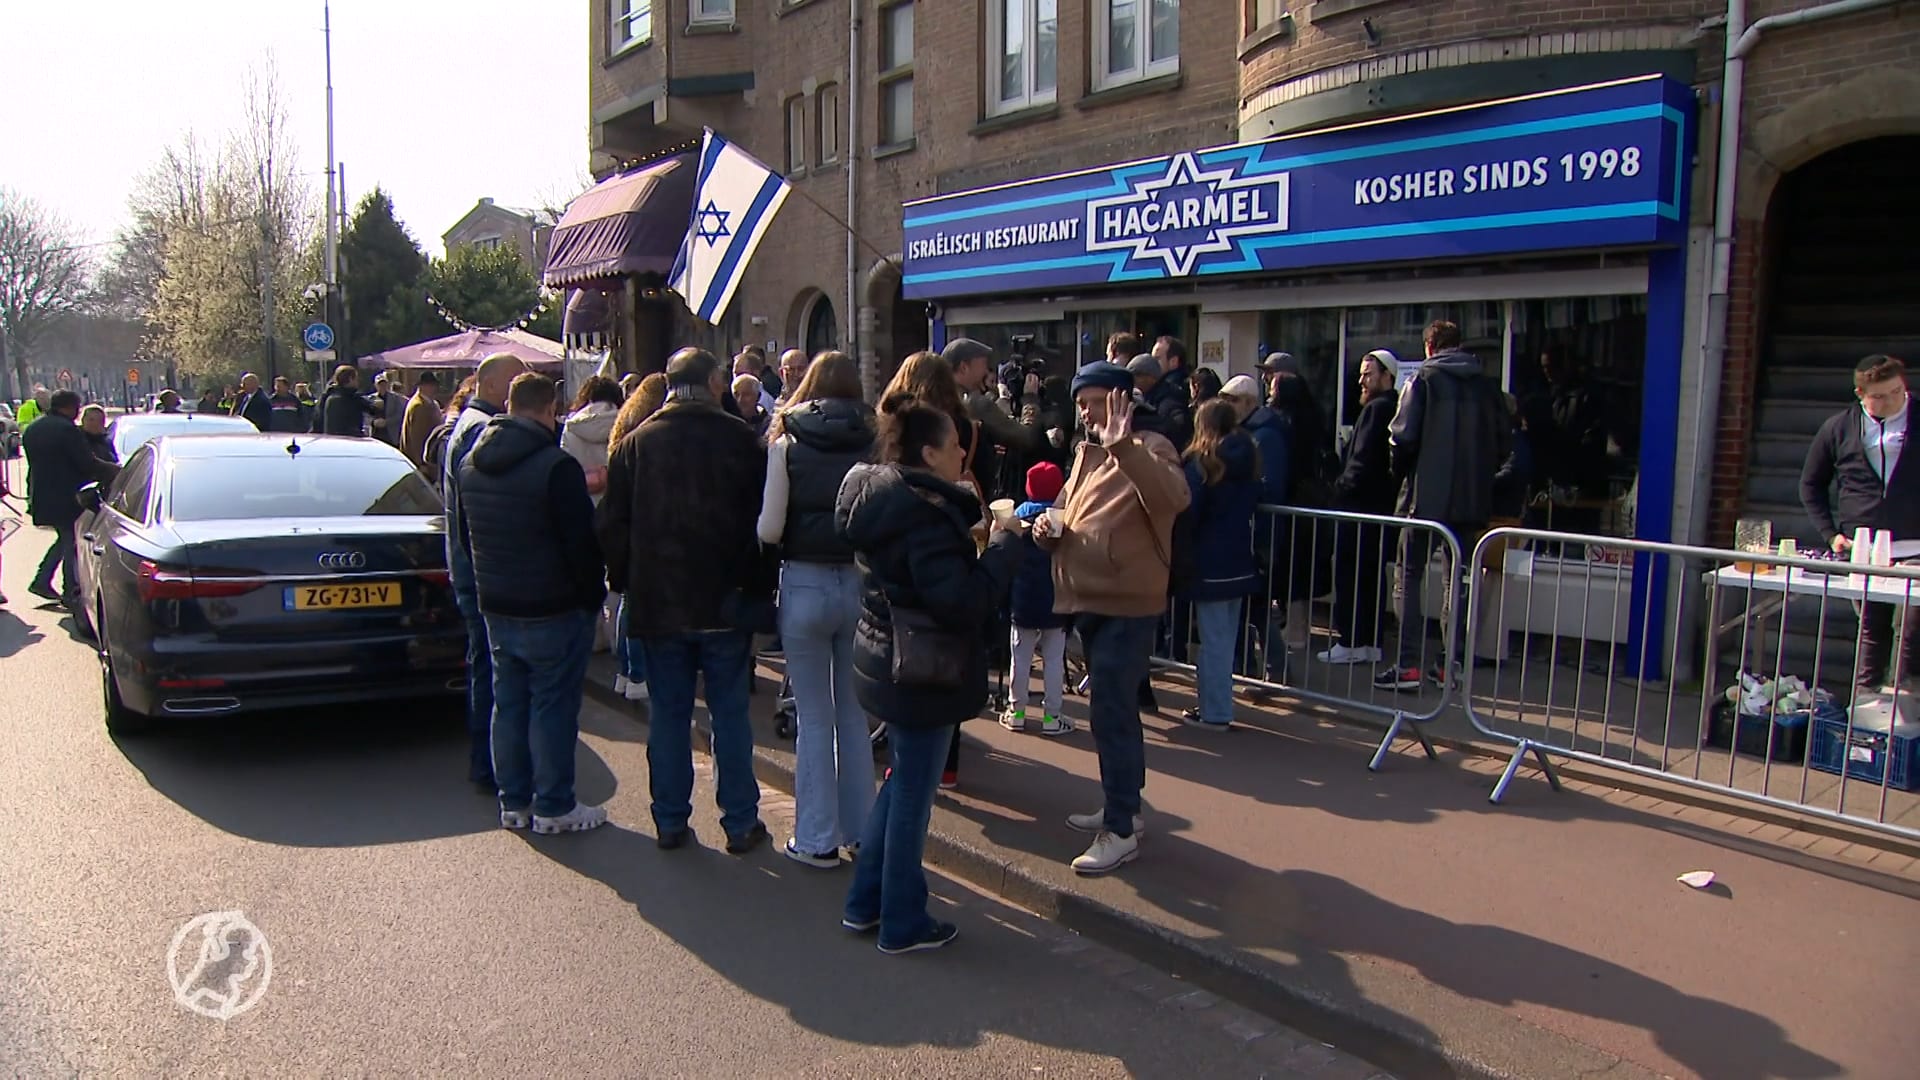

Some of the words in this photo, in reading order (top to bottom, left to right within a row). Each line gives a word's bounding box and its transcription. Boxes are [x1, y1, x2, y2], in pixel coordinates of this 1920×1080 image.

[1354, 168, 1455, 205] KOSHER
[1462, 156, 1549, 194] SINDS
[1559, 146, 1641, 183] 1998
[1103, 189, 1269, 239] HACARMEL
[908, 231, 981, 260] ISRAËLISCH
[985, 218, 1079, 250] RESTAURANT
[306, 586, 389, 606] ZG-731-V
